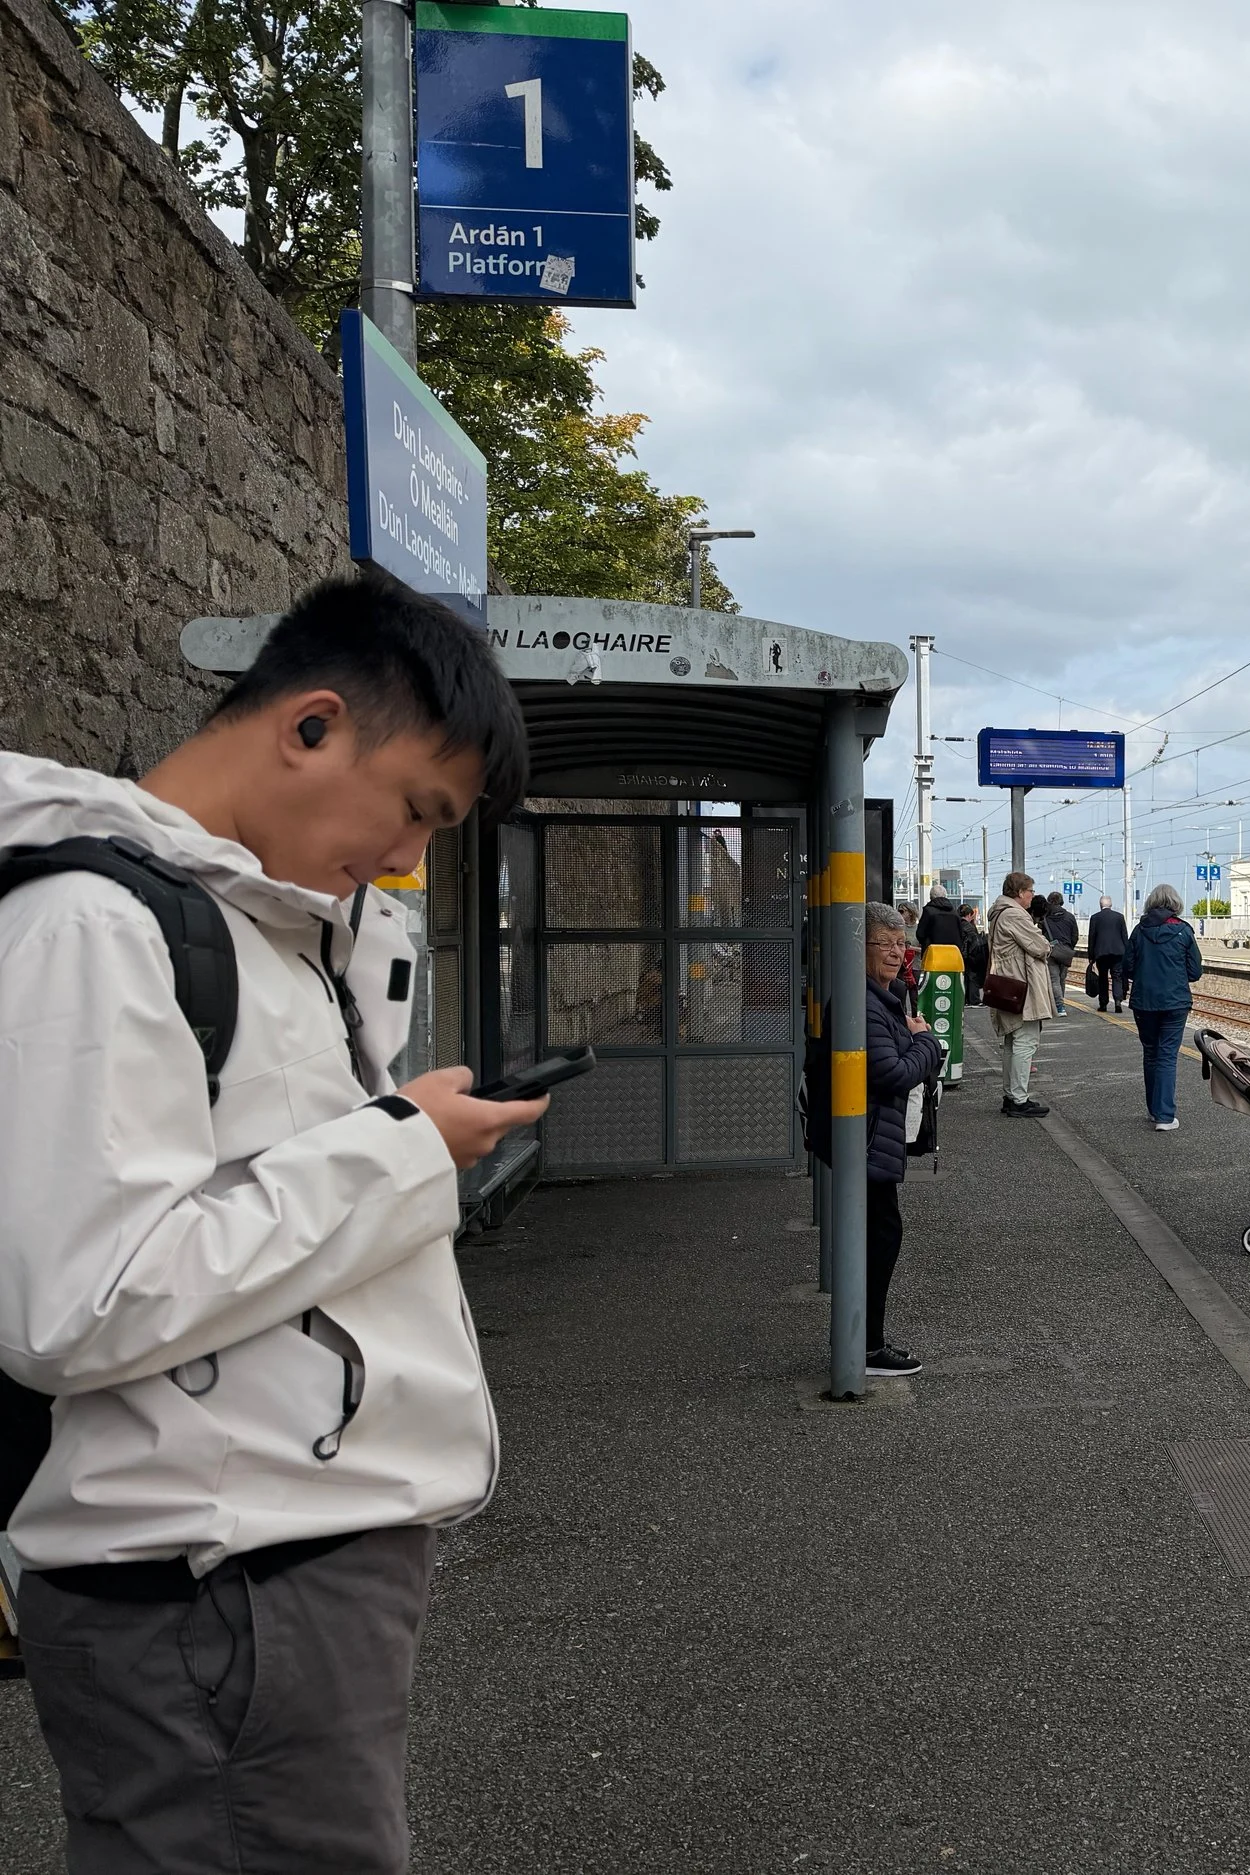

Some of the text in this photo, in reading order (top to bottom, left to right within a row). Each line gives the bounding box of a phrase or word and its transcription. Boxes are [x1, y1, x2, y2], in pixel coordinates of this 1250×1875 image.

[504, 78, 543, 169] 1
[448, 222, 542, 247] Ardán 1
[393, 400, 416, 457] Dún
[418, 427, 463, 505] Laoghaire
[409, 463, 459, 547] Ó Mealláin
[378, 489, 403, 545] Dún
[404, 512, 451, 585] Laoghaire
[459, 562, 482, 611] Mallin
[516, 629, 672, 653] LAOGHAIRE
